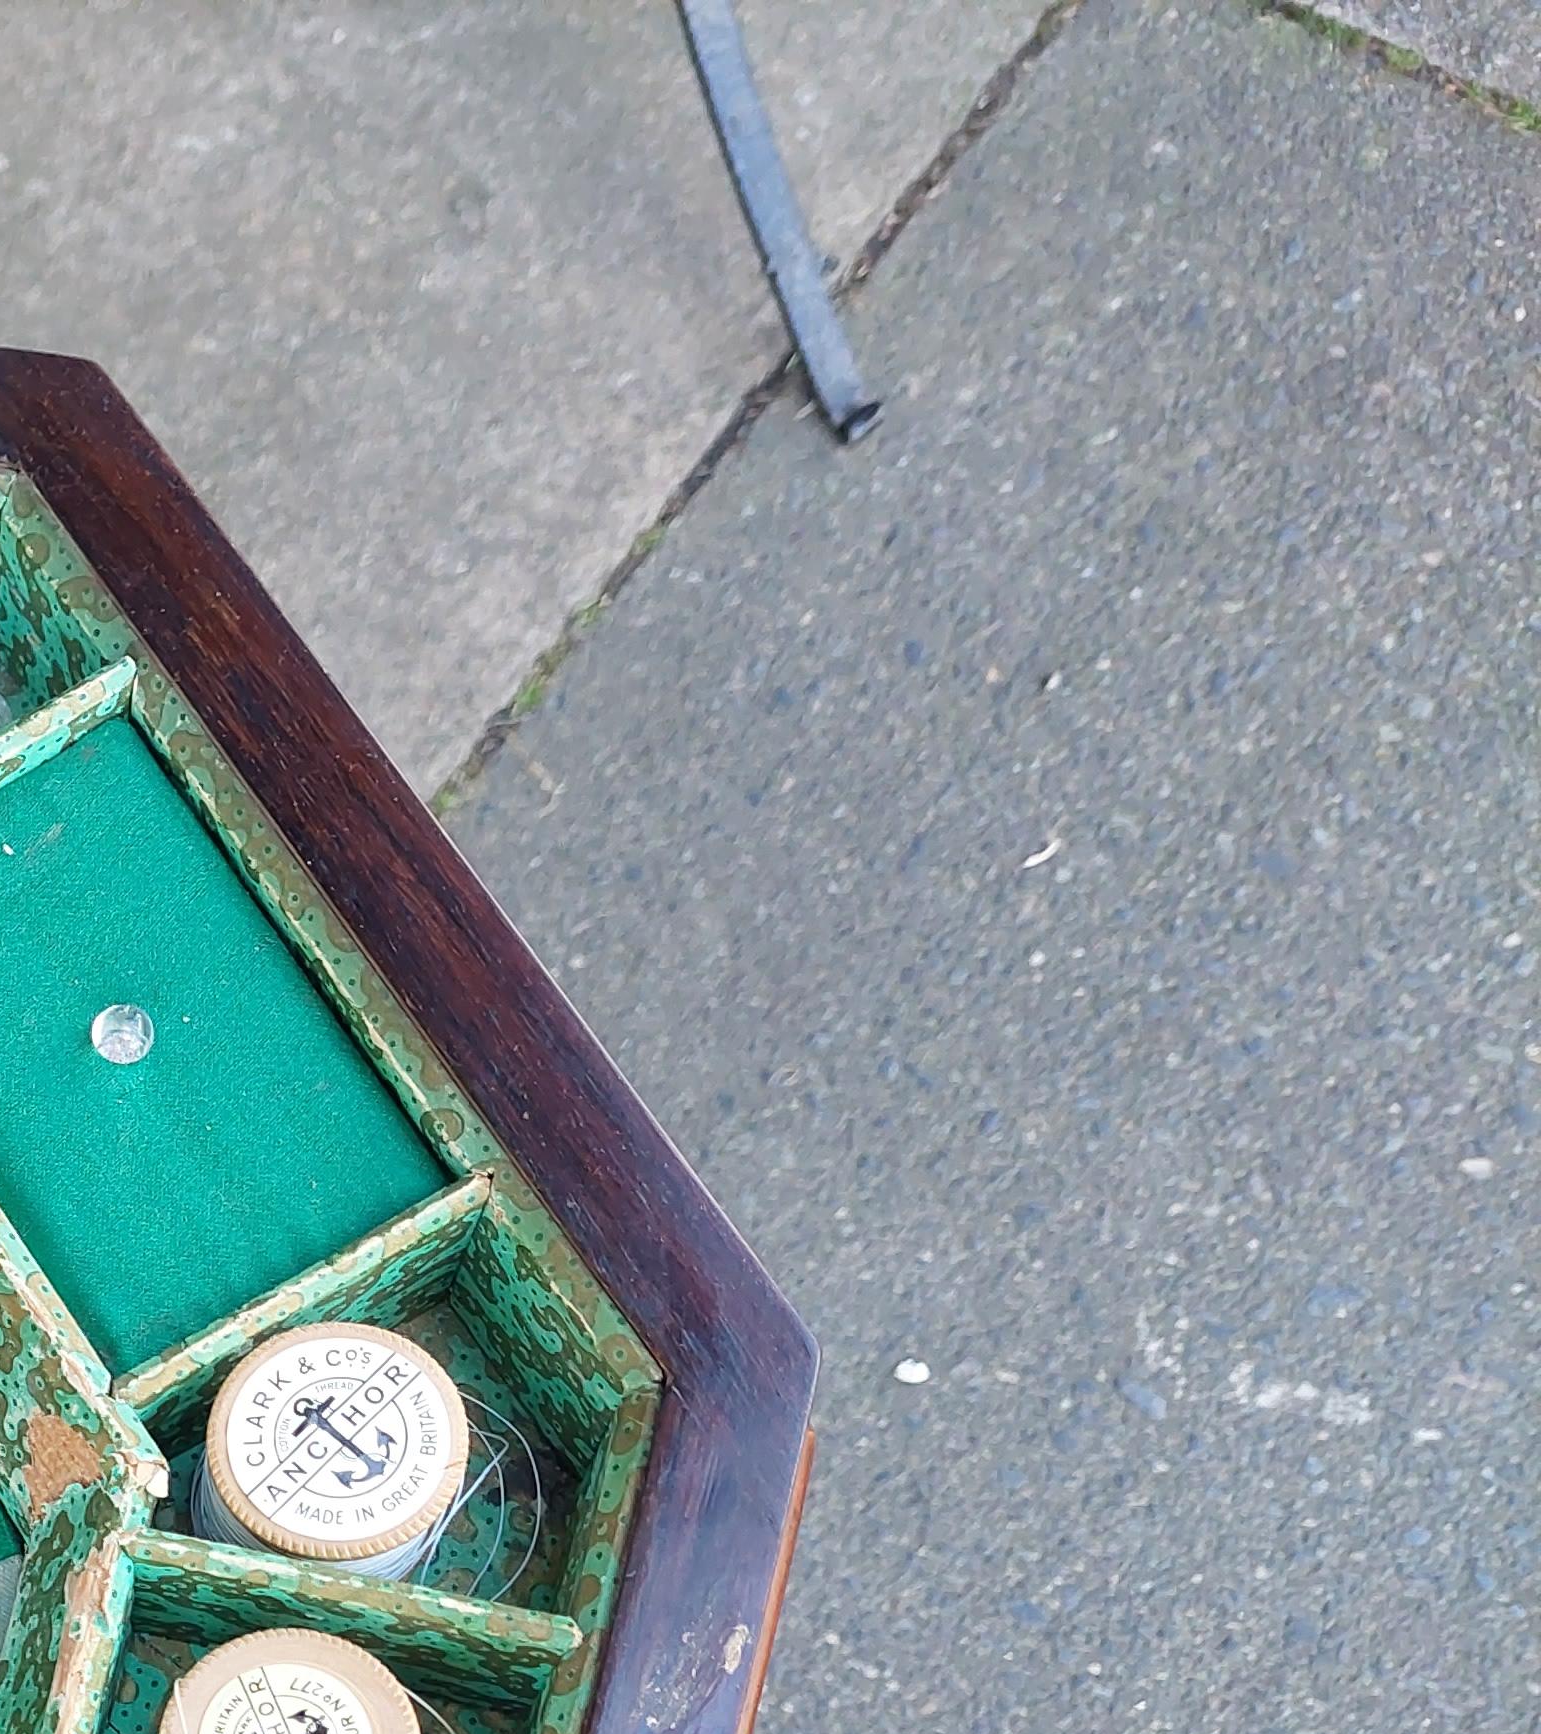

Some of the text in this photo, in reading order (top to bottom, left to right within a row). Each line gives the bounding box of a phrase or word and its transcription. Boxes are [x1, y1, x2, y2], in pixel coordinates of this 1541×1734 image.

[243, 1370, 292, 1467] CLARK
[298, 1357, 316, 1374] &
[266, 1364, 409, 1502] ANCHOR
[294, 1390, 438, 1525] MADE IN GREAT BRITAIN
